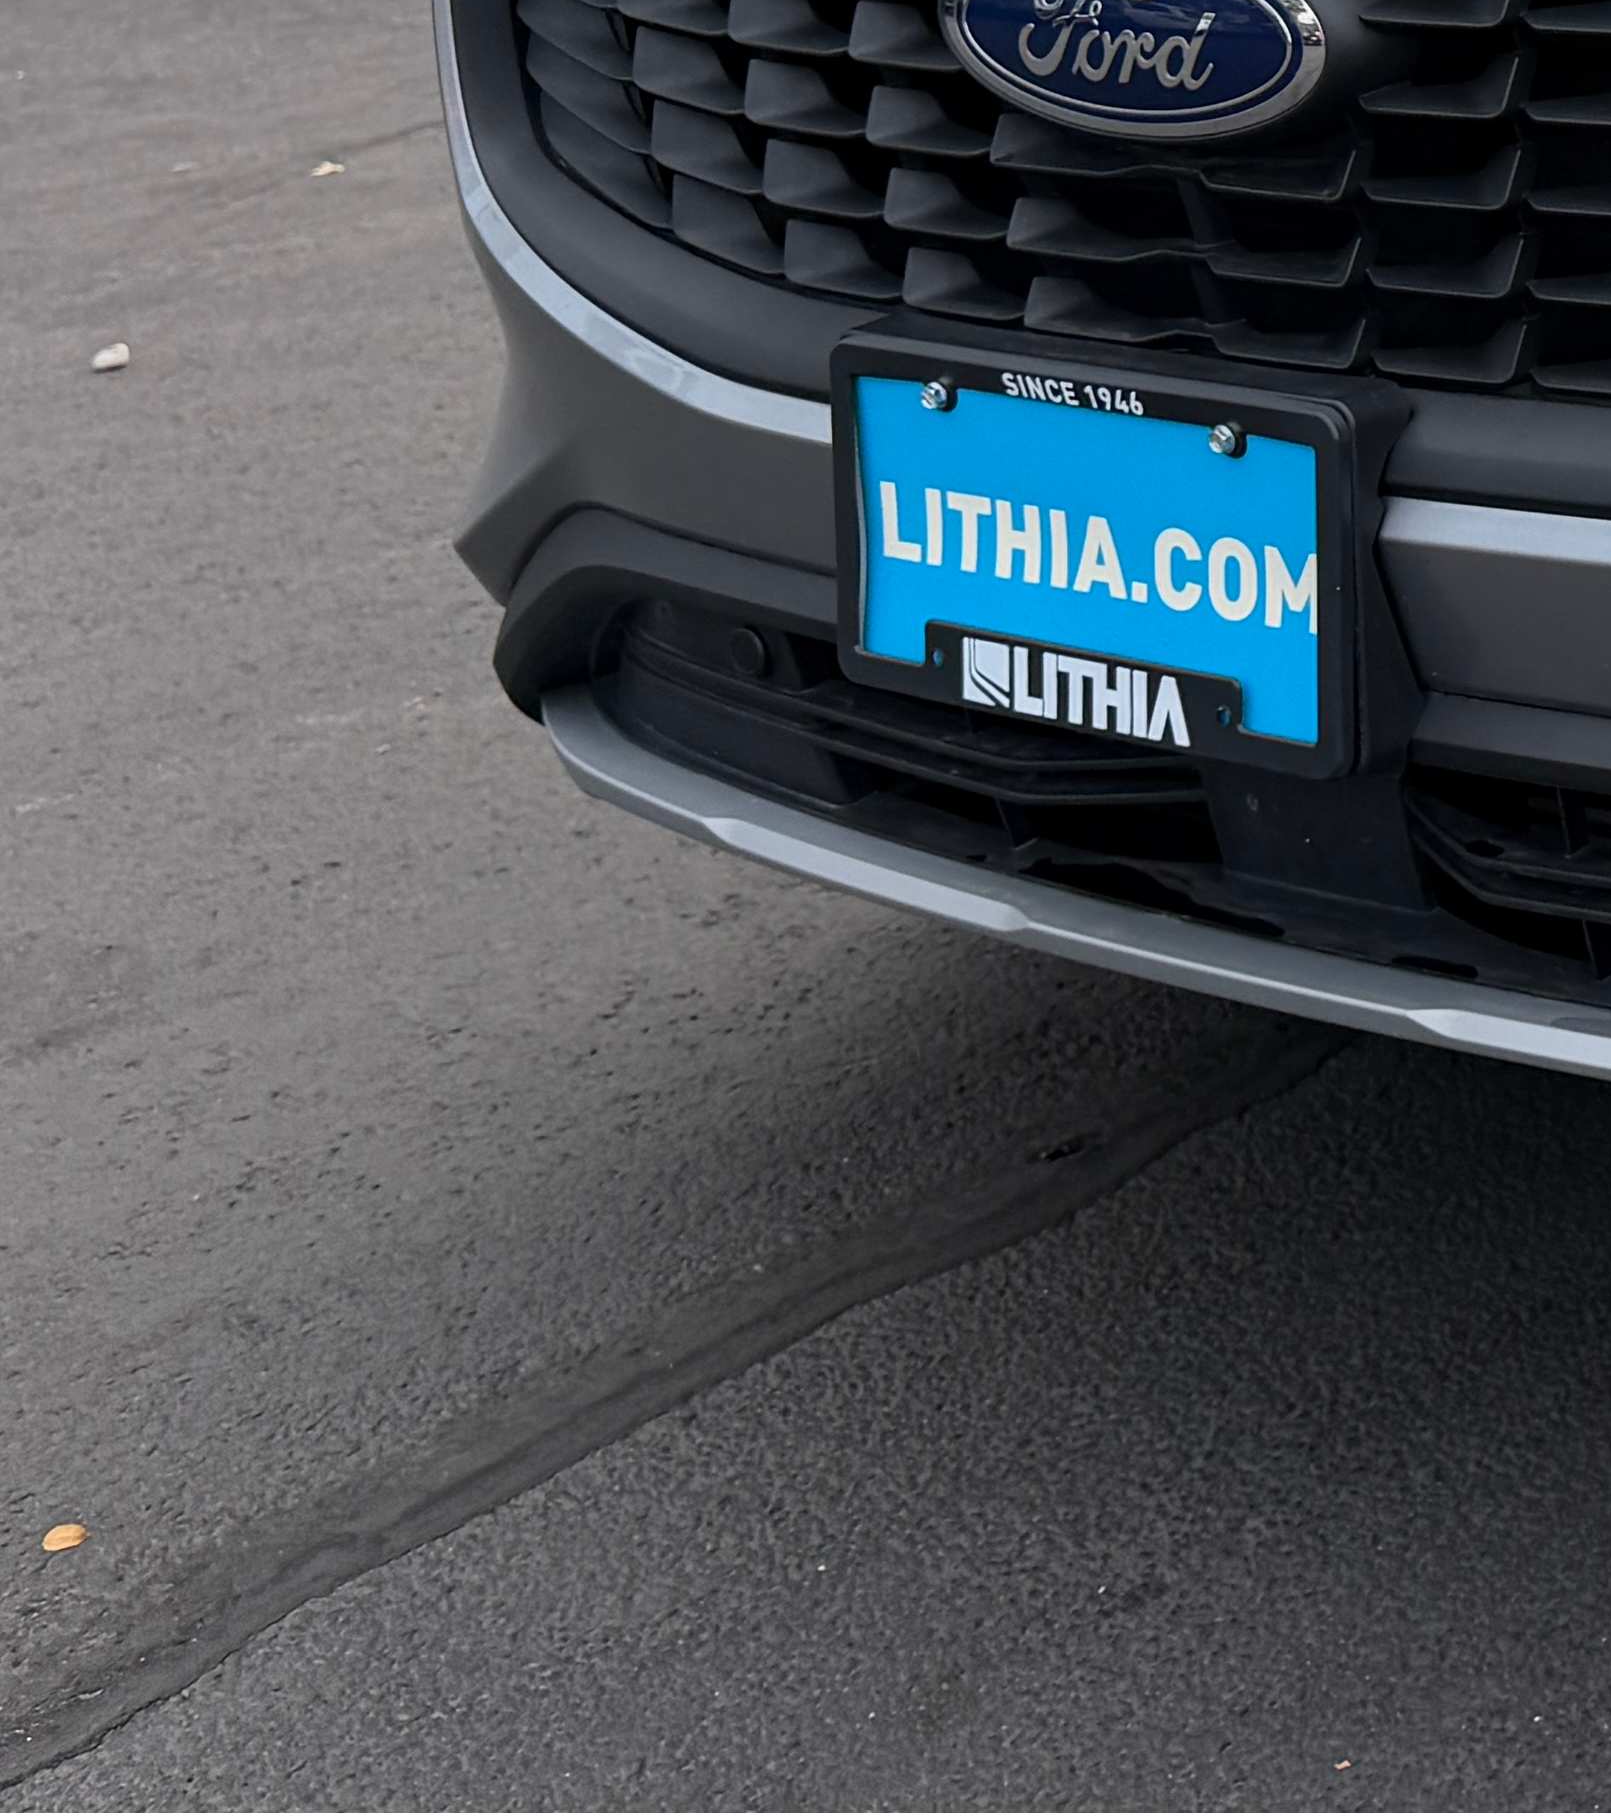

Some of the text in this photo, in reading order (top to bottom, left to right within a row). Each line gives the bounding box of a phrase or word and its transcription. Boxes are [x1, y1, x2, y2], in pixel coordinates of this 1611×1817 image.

[1001, 372, 1144, 416] SINCE 1946
[879, 480, 1318, 636] LITHIA.COM
[1012, 645, 1191, 748] LITHIA
